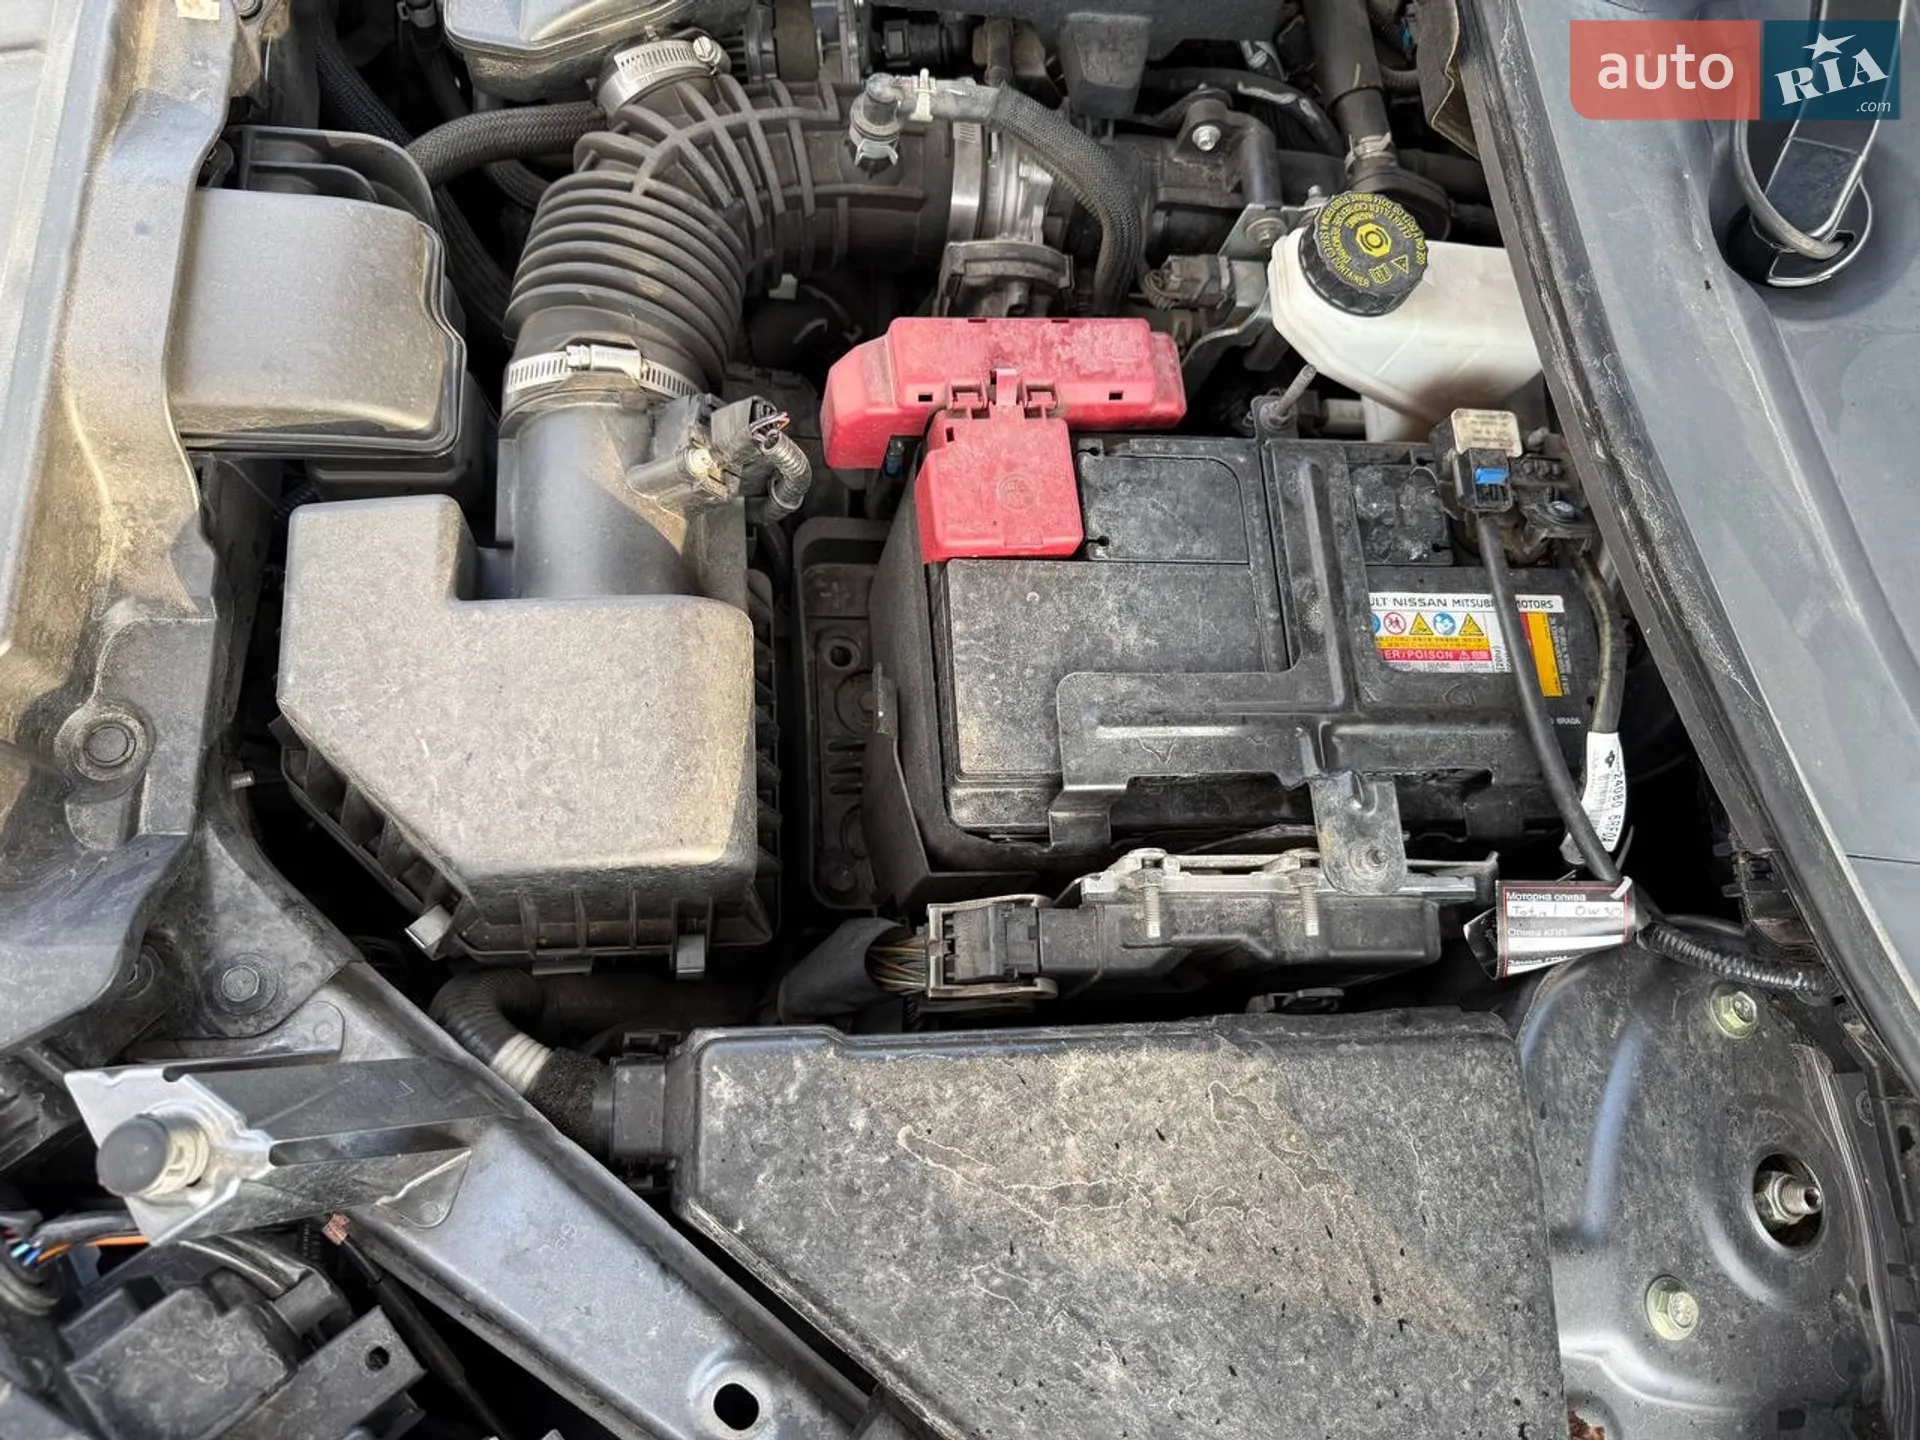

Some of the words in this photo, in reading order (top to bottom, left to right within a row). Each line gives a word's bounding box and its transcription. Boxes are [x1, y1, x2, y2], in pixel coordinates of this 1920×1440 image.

[1393, 598, 1448, 608] NISSAN
[1384, 650, 1453, 660] ER/POISON
[1506, 892, 1552, 902] Моторна
[1554, 893, 1586, 902] олива
